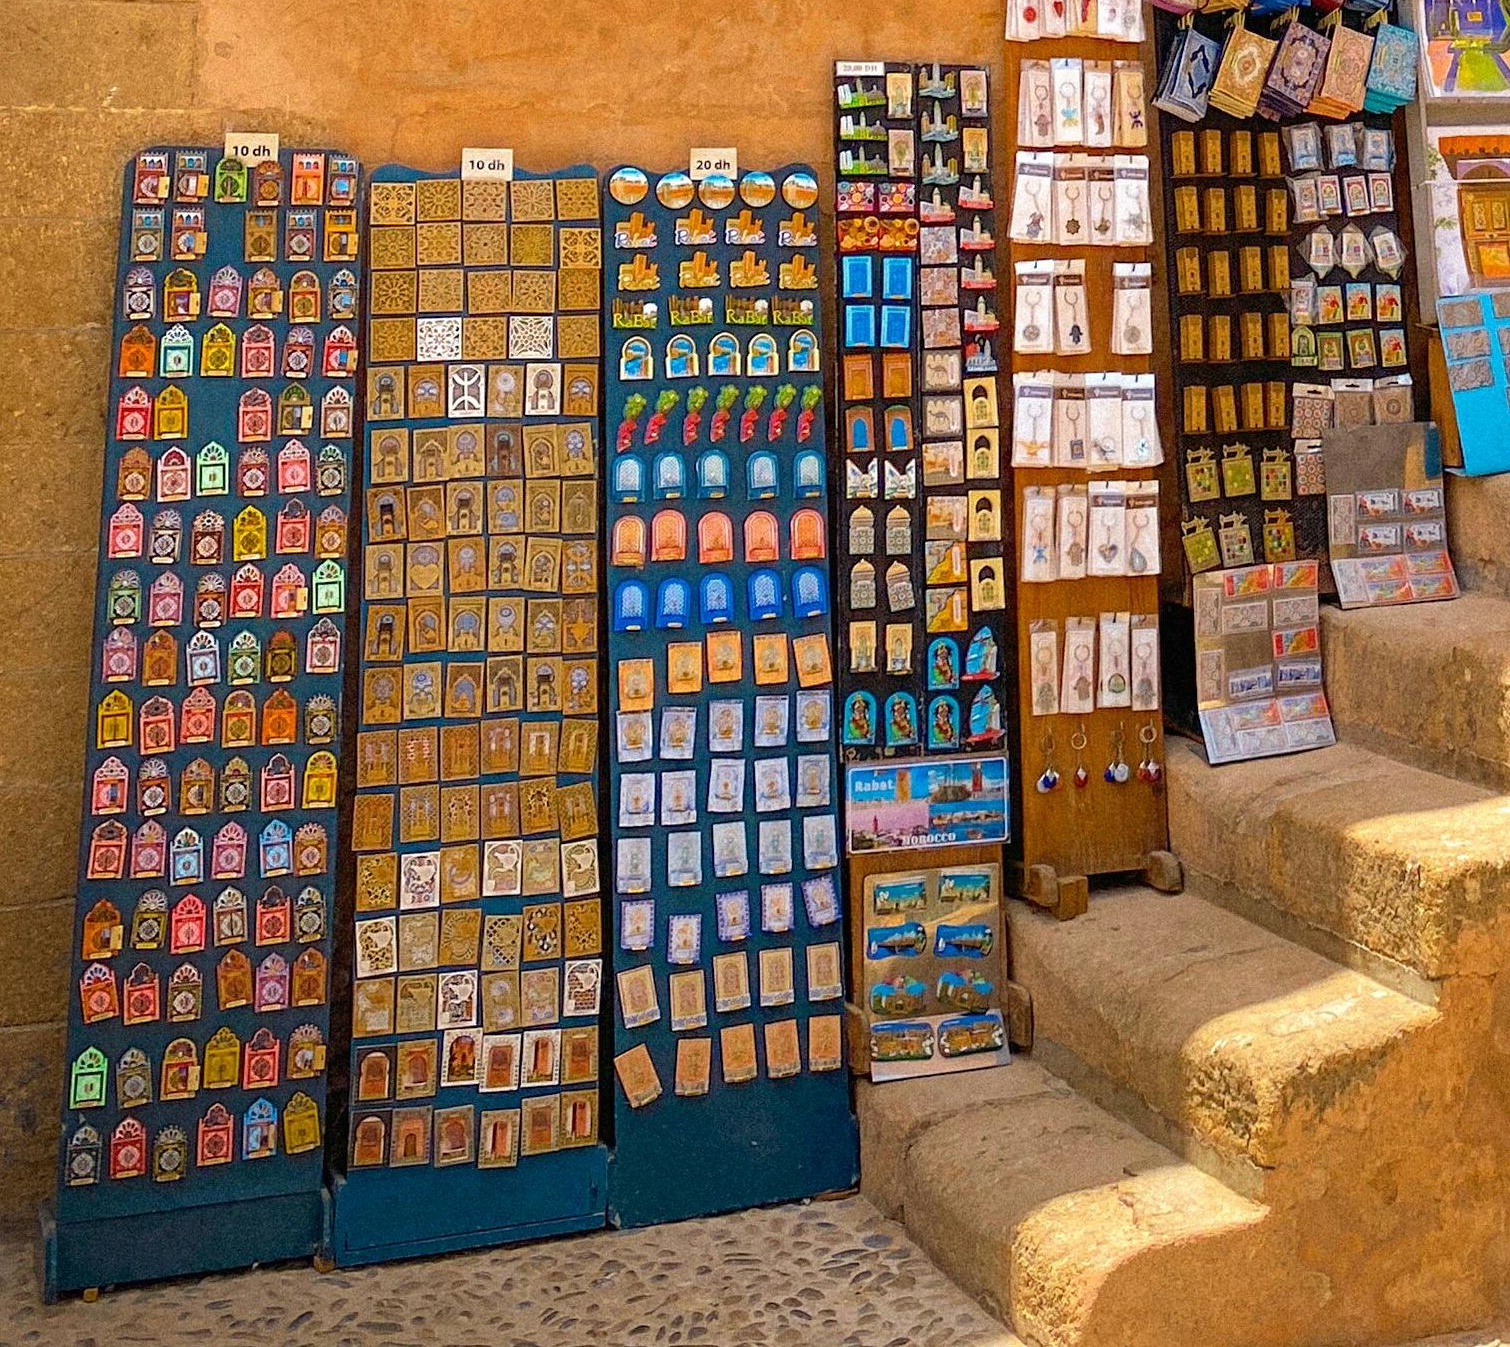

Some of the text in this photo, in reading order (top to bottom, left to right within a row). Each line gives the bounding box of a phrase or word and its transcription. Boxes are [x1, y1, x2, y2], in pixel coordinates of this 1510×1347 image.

[232, 144, 271, 157] 10 dh
[469, 158, 505, 171] 10 dh
[696, 158, 731, 170] 20 dh
[854, 779, 895, 793] Rabat
